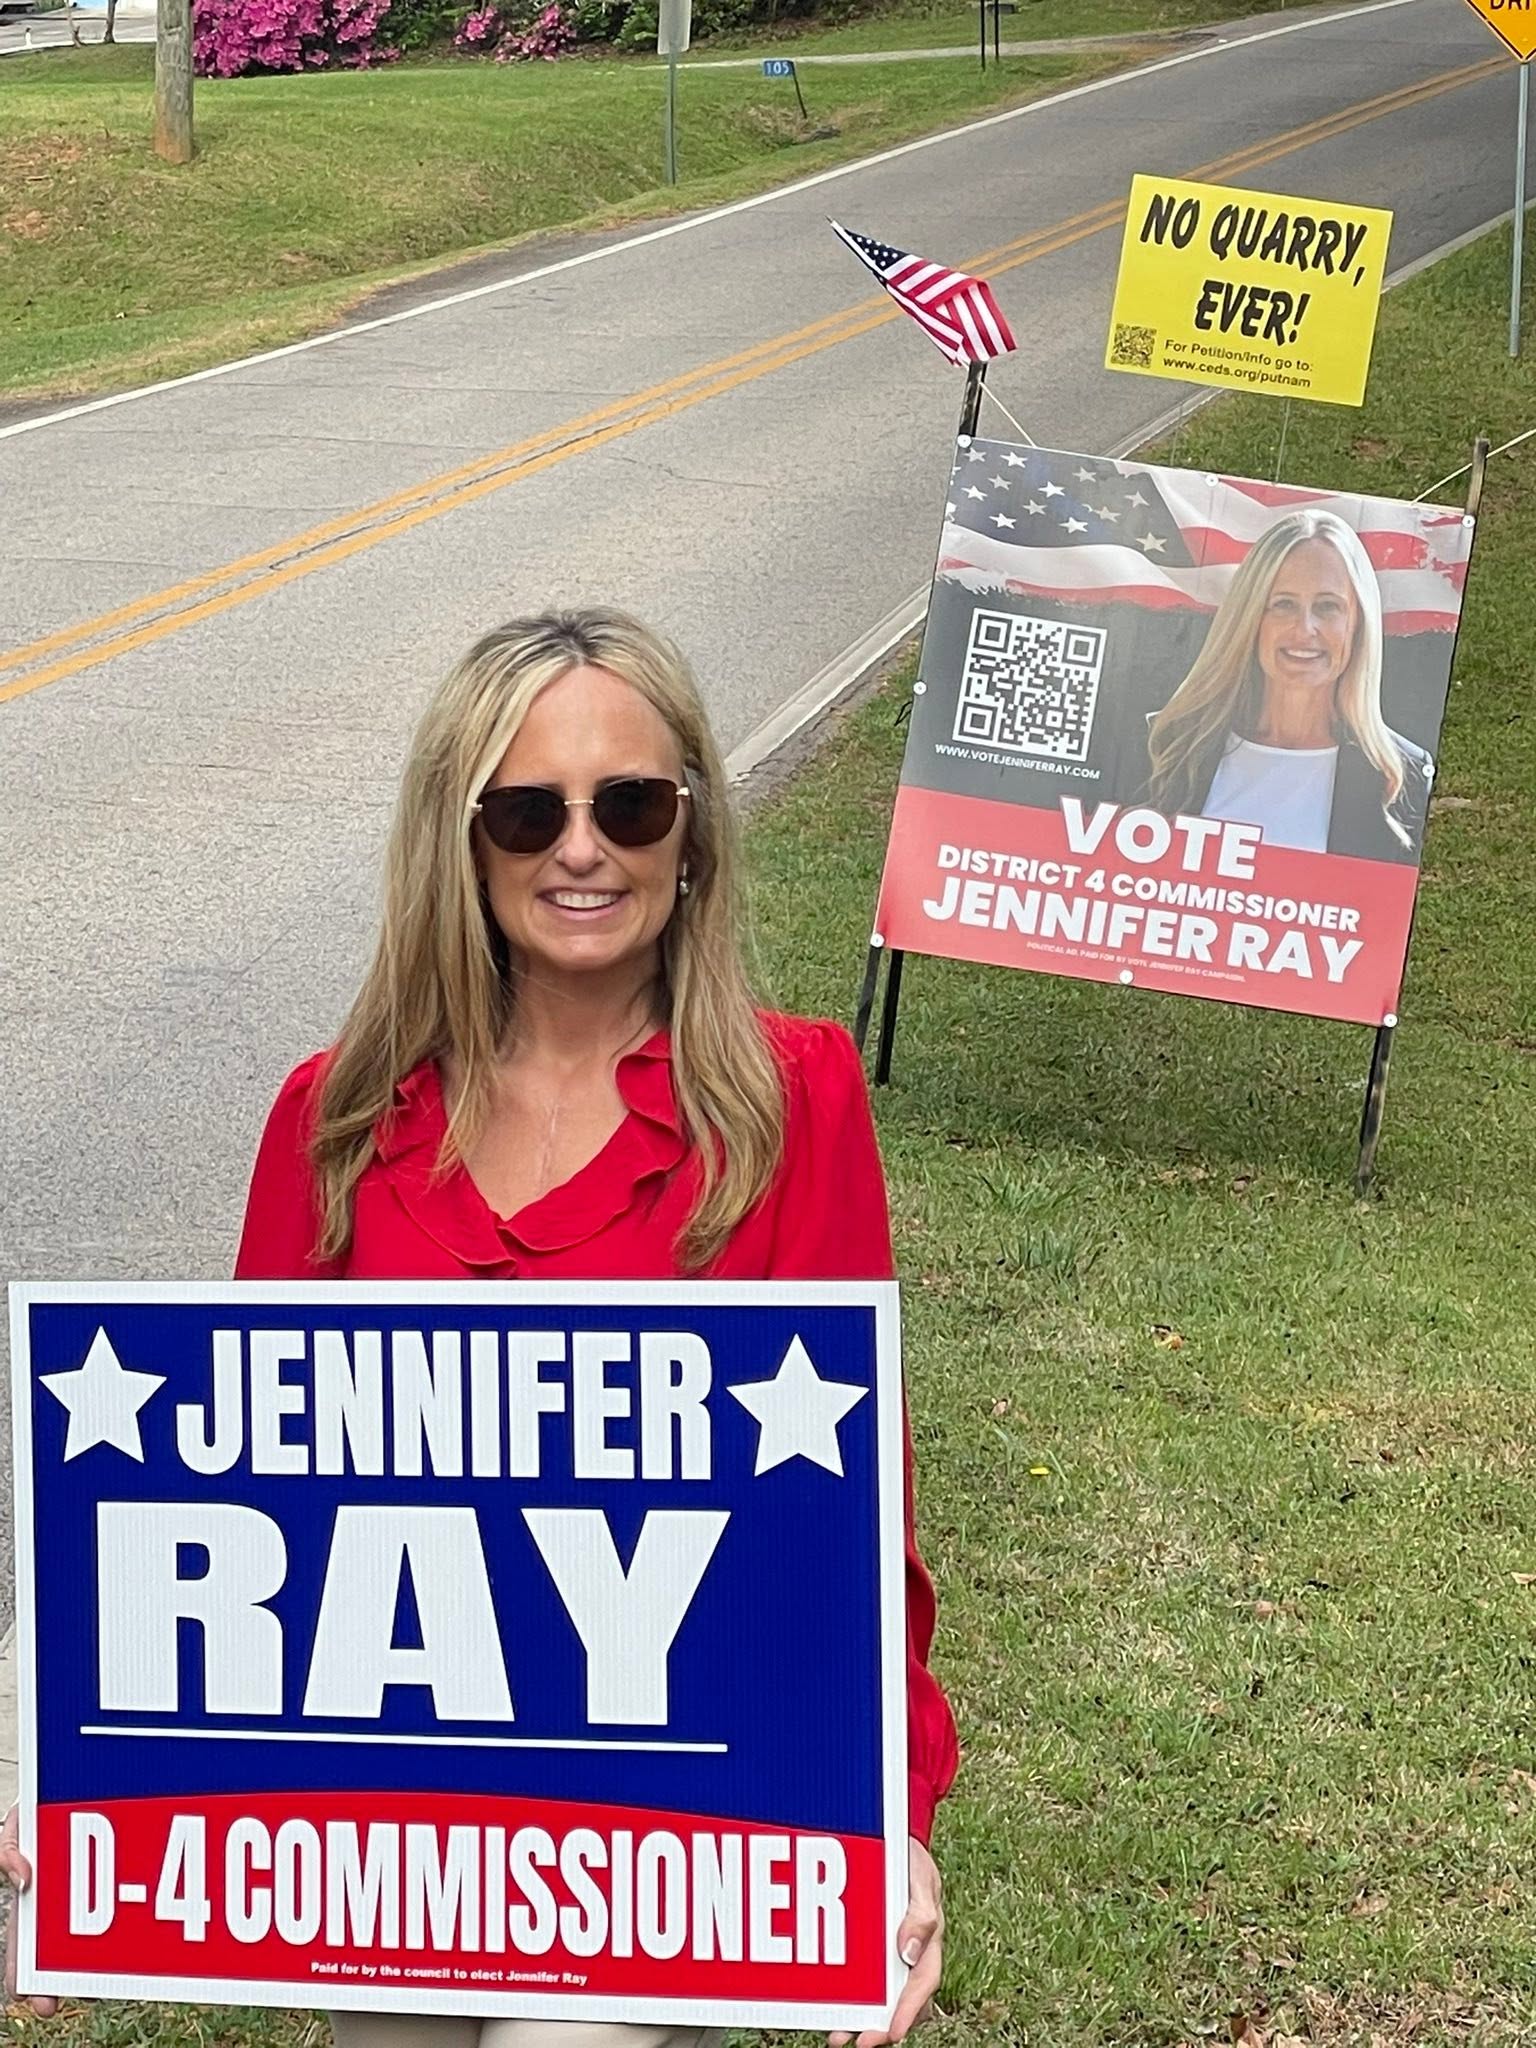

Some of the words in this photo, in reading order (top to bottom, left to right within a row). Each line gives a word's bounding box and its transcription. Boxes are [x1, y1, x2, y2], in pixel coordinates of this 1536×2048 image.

[766, 61, 789, 74] 105
[1139, 193, 1201, 249] NO
[1209, 204, 1368, 287] QUARRY,
[1194, 279, 1311, 346] EVER!
[1163, 357, 1311, 388] www.ceds.org/putnam
[1165, 339, 1187, 352] For
[1191, 343, 1272, 366] Petition/Info
[1275, 358, 1293, 371] go
[1296, 360, 1313, 371] to:
[935, 744, 1101, 780] WWW.VOTEJENNIFERRAY.COM
[1060, 796, 1263, 880] VOTE
[922, 876, 1218, 963] JENNIFER
[1226, 921, 1364, 983] RAY
[937, 844, 1082, 889] DISTRICT
[1084, 869, 1106, 893] 4
[1111, 873, 1361, 933] COMMISSIONER
[176, 1329, 713, 1481] JENNIFER
[96, 1500, 732, 1727] RAY
[68, 1811, 211, 1944] D-4
[224, 1816, 848, 1966] COMMISSIONER
[310, 1962, 338, 1973] Paid
[340, 1963, 358, 1975] for
[361, 1963, 377, 1978] by
[380, 1964, 401, 1977] the
[404, 1966, 450, 1979] council
[453, 1968, 468, 1979] to
[470, 1970, 503, 1981] elect
[506, 1972, 559, 1983] Jennifer
[562, 1973, 588, 1986] Ray
